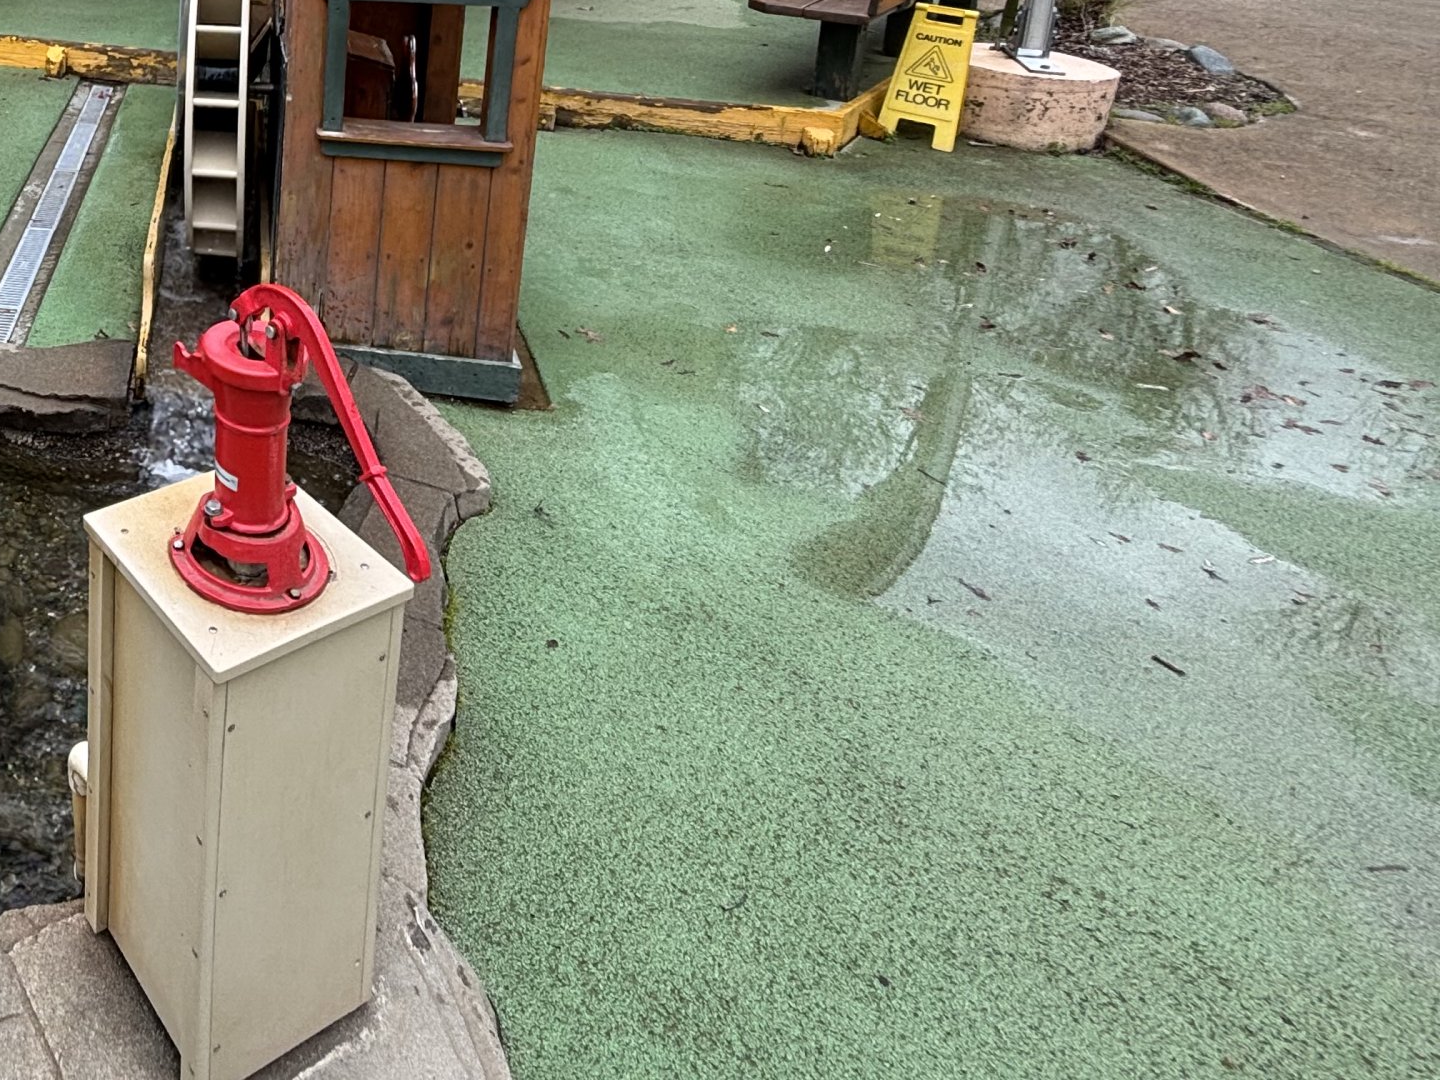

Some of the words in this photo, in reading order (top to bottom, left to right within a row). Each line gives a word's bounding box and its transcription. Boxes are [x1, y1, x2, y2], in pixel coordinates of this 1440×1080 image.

[916, 33, 963, 47] CAUTION
[908, 79, 945, 95] WET
[896, 89, 950, 110] FLOOR
